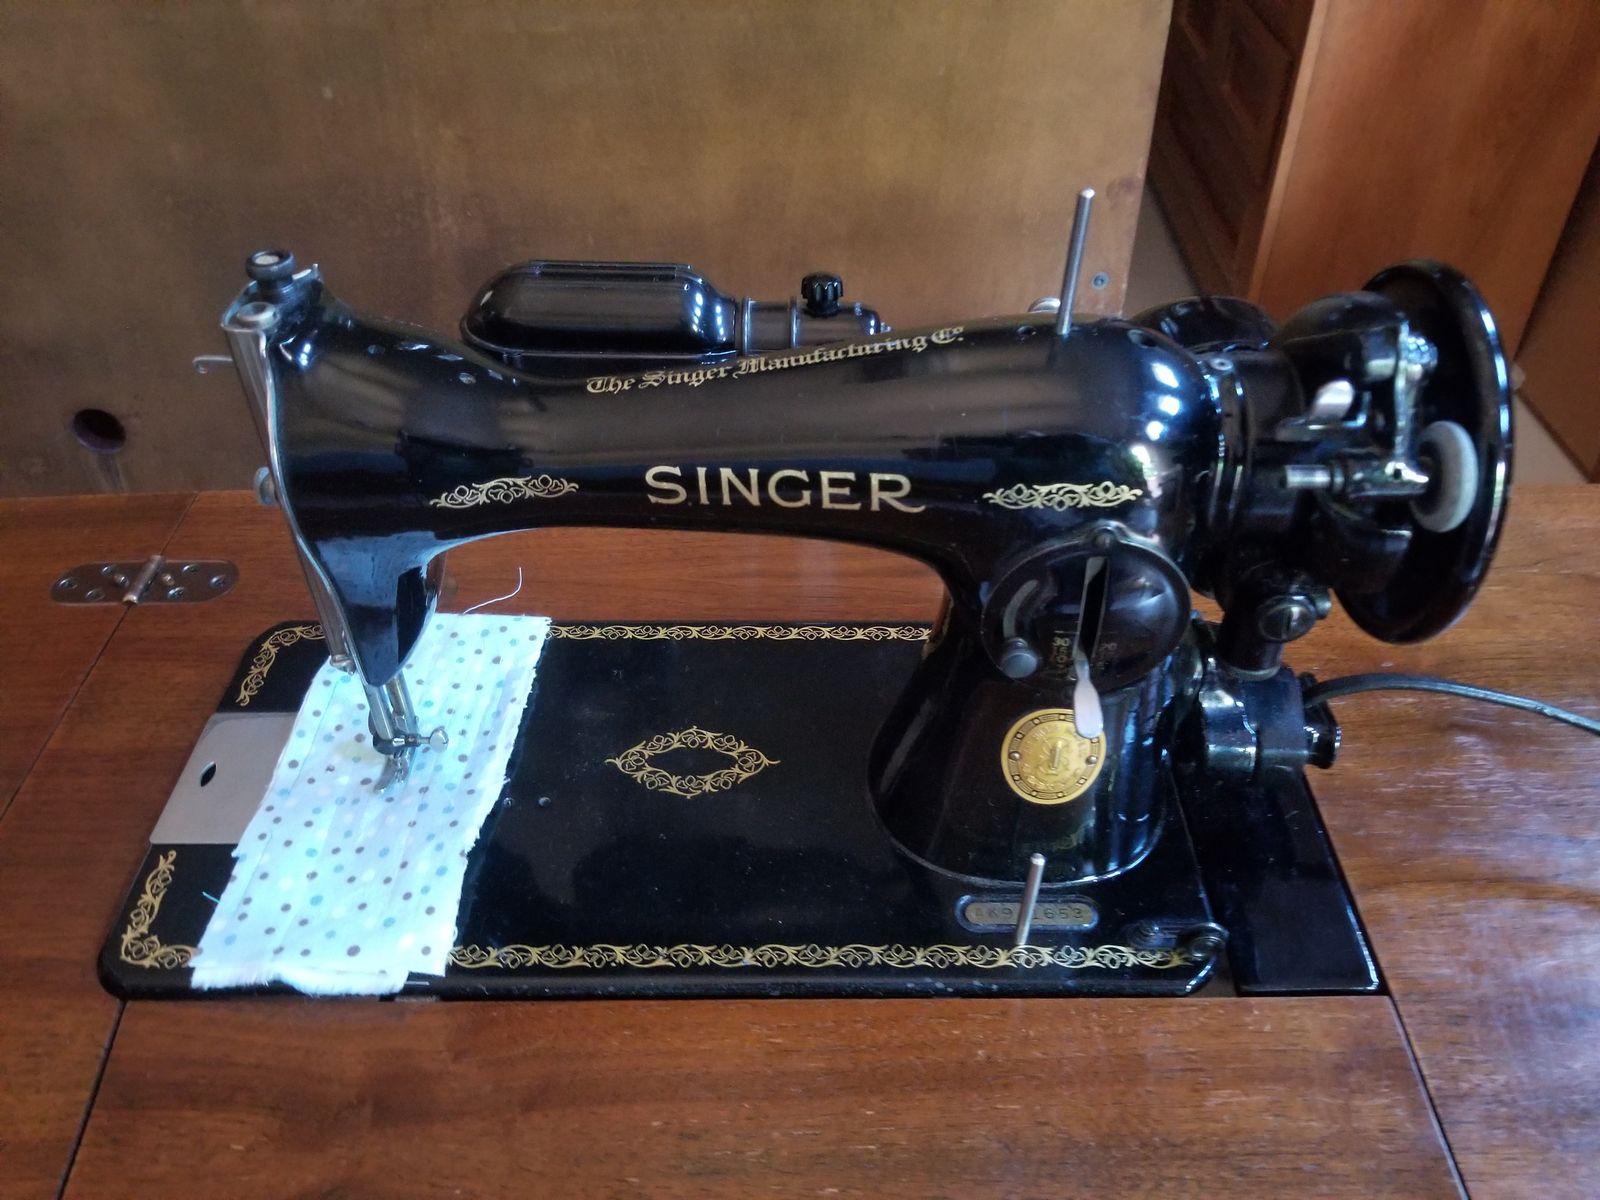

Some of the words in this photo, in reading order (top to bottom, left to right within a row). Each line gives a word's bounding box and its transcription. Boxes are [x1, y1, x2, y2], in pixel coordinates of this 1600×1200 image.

[586, 376, 636, 394] The
[638, 364, 733, 390] Singer
[732, 336, 928, 379] Manufacturing
[645, 465, 926, 513] SINGER
